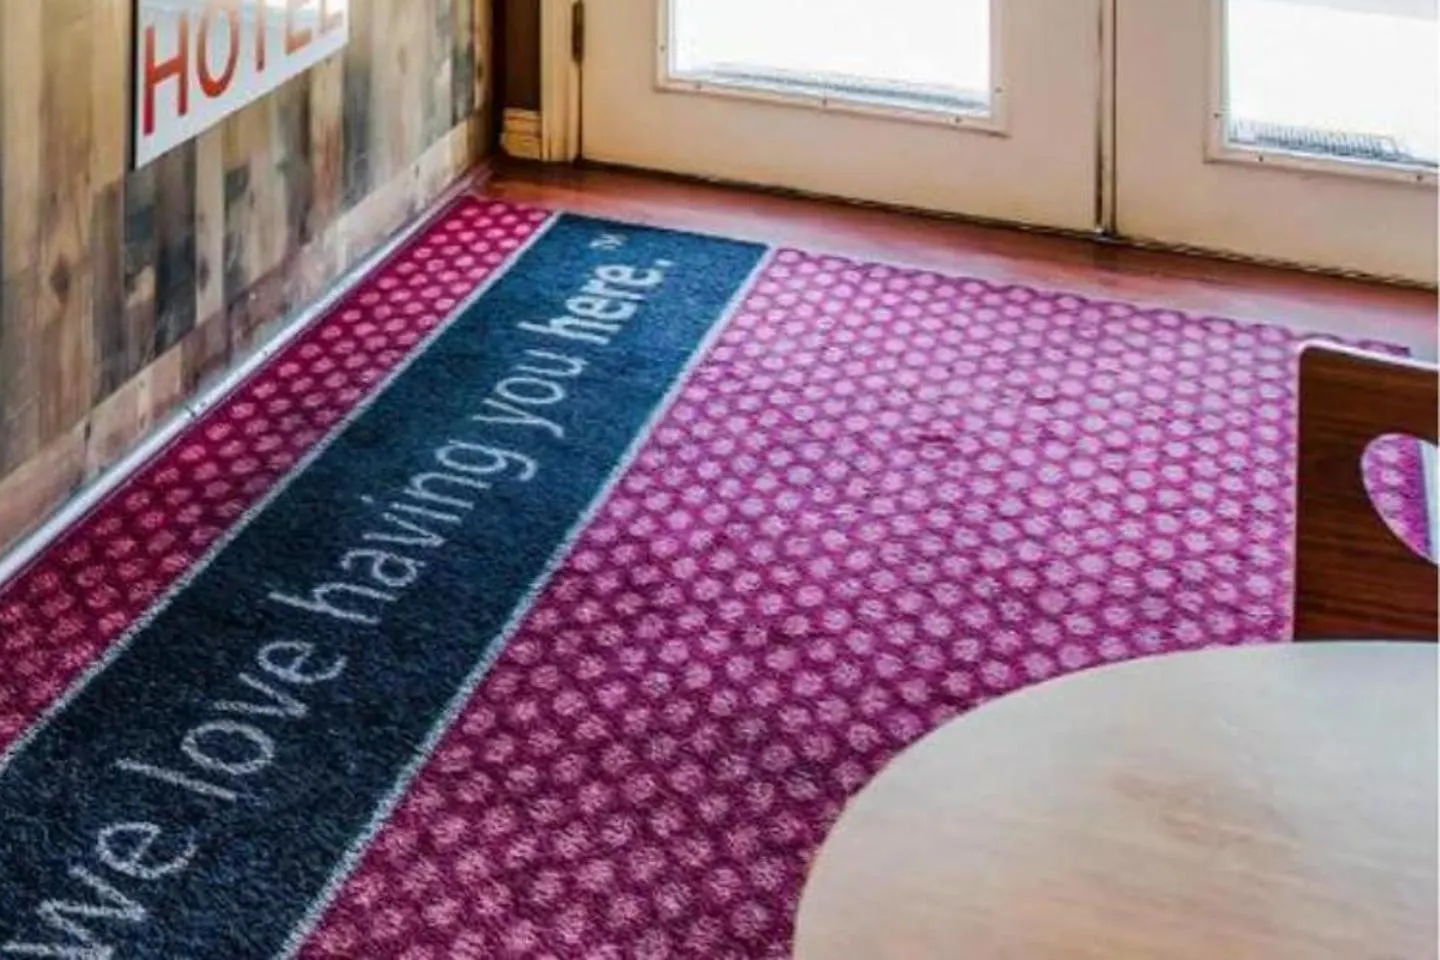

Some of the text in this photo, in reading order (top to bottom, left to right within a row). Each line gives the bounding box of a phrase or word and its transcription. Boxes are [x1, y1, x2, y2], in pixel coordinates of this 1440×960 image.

[0, 820, 199, 959] we
[120, 638, 346, 800] love
[268, 439, 537, 623] having
[472, 347, 589, 438] you
